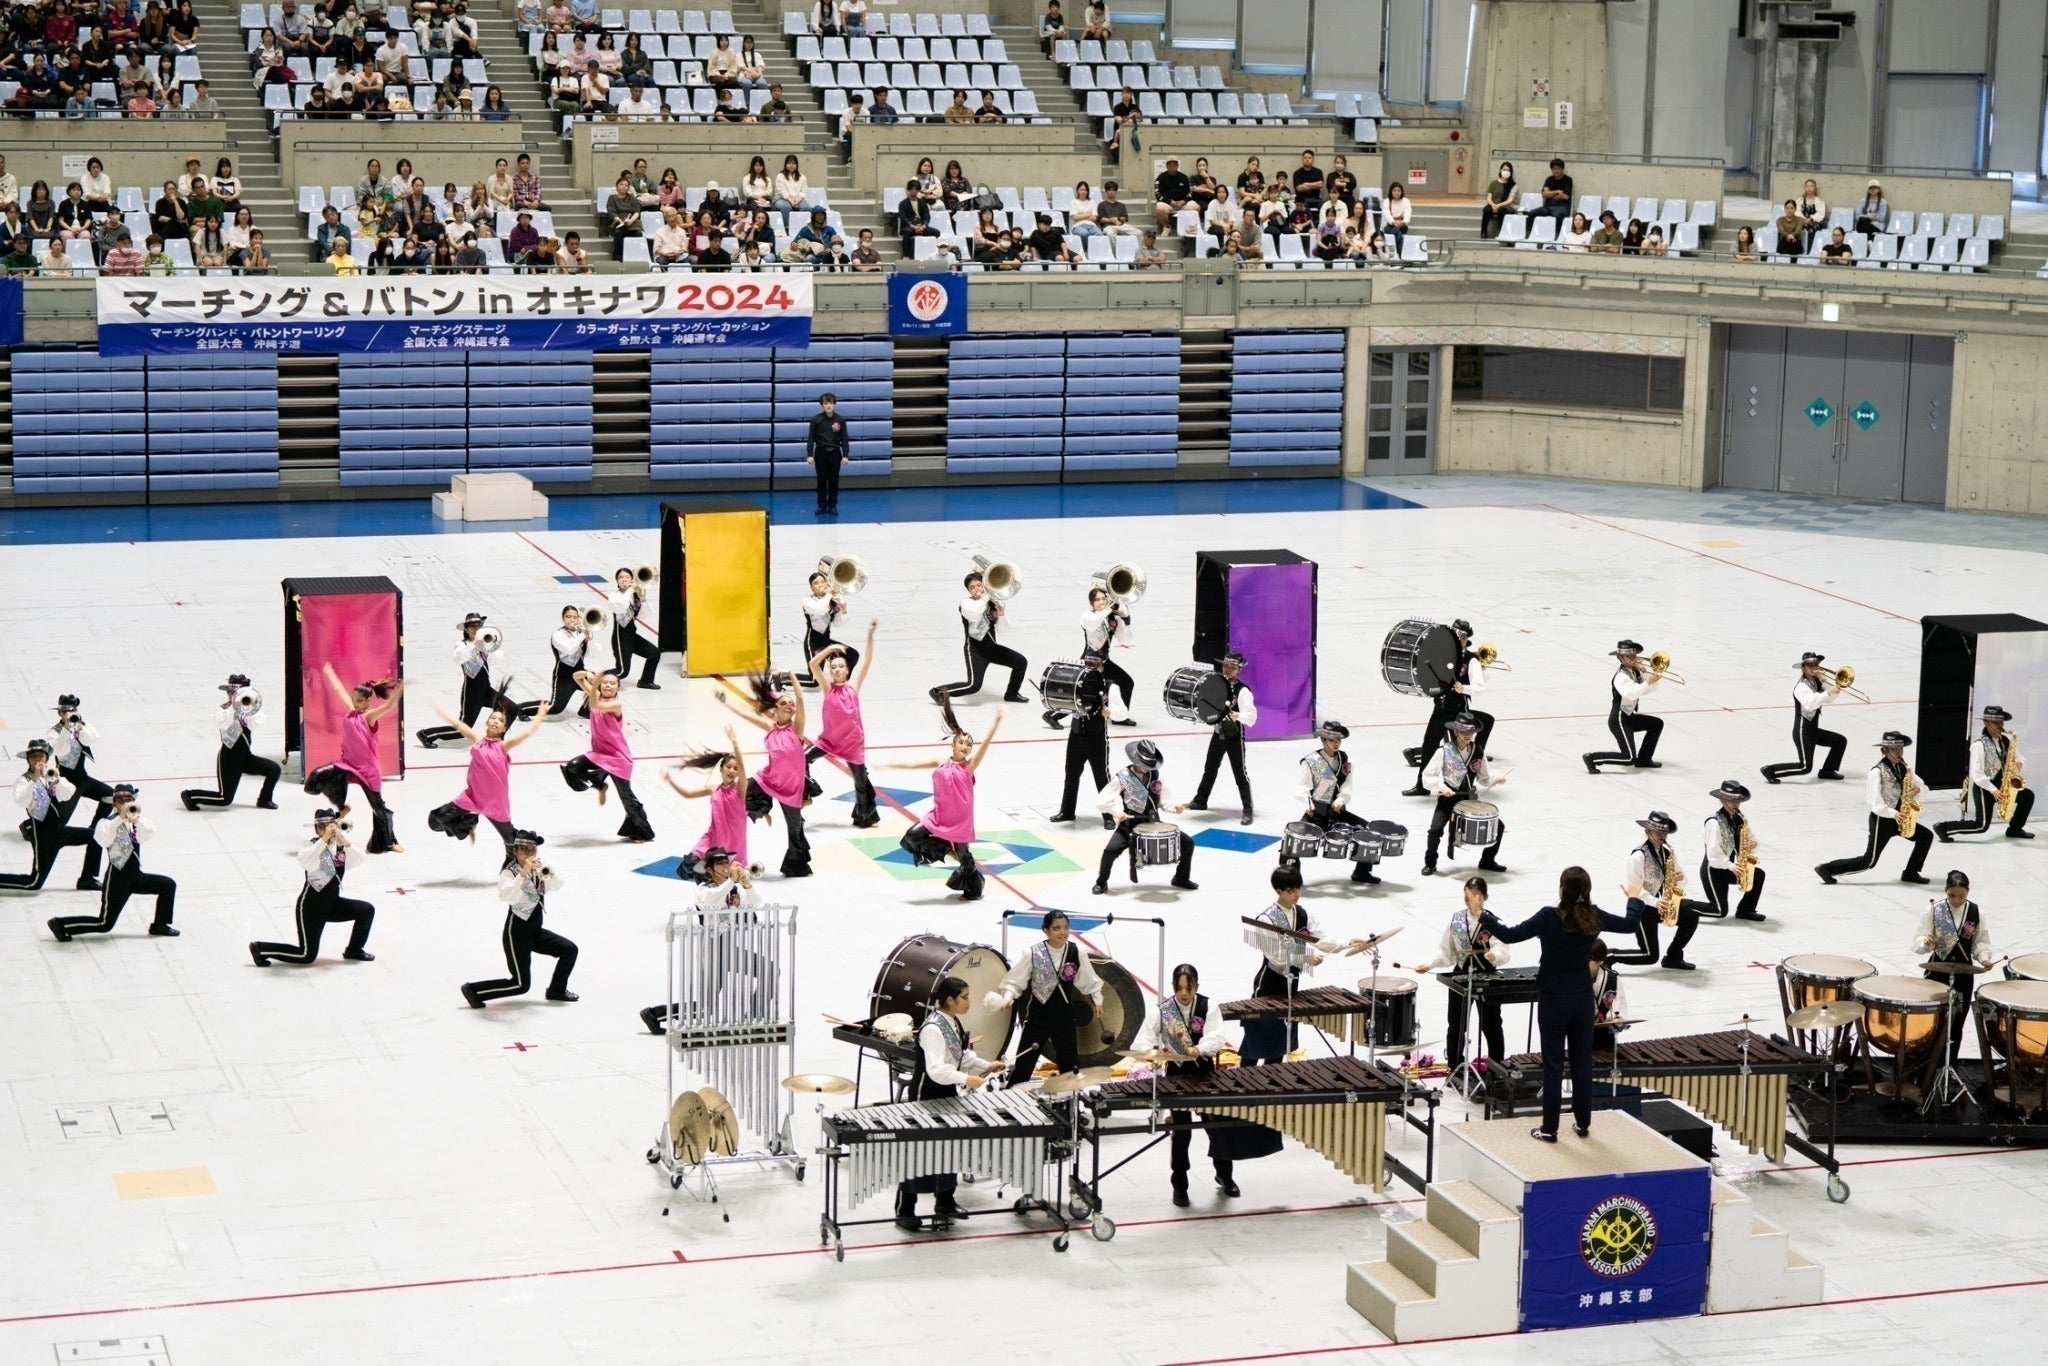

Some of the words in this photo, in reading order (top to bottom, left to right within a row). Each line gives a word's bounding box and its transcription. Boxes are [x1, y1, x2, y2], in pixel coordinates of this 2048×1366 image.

[123, 287, 311, 318] マーチング
[322, 292, 350, 317] &
[361, 286, 465, 316] バトン
[478, 287, 512, 315] in
[526, 285, 666, 315] オキナワ
[677, 284, 795, 311] 2024
[409, 324, 507, 335] マーチングステージ
[196, 338, 243, 349] 全国大会
[254, 339, 302, 349] 沖縄予選
[403, 337, 449, 348] 全国大会
[453, 336, 510, 347] 沖縄選考会
[618, 335, 662, 346] 全国大会
[1581, 1211, 1600, 1243] JAPAN
[1597, 1197, 1656, 1237] MARCHINGBAND
[1588, 1251, 1648, 1275] ASSOCIATION
[1579, 1287, 1653, 1308] 沖縄支部
